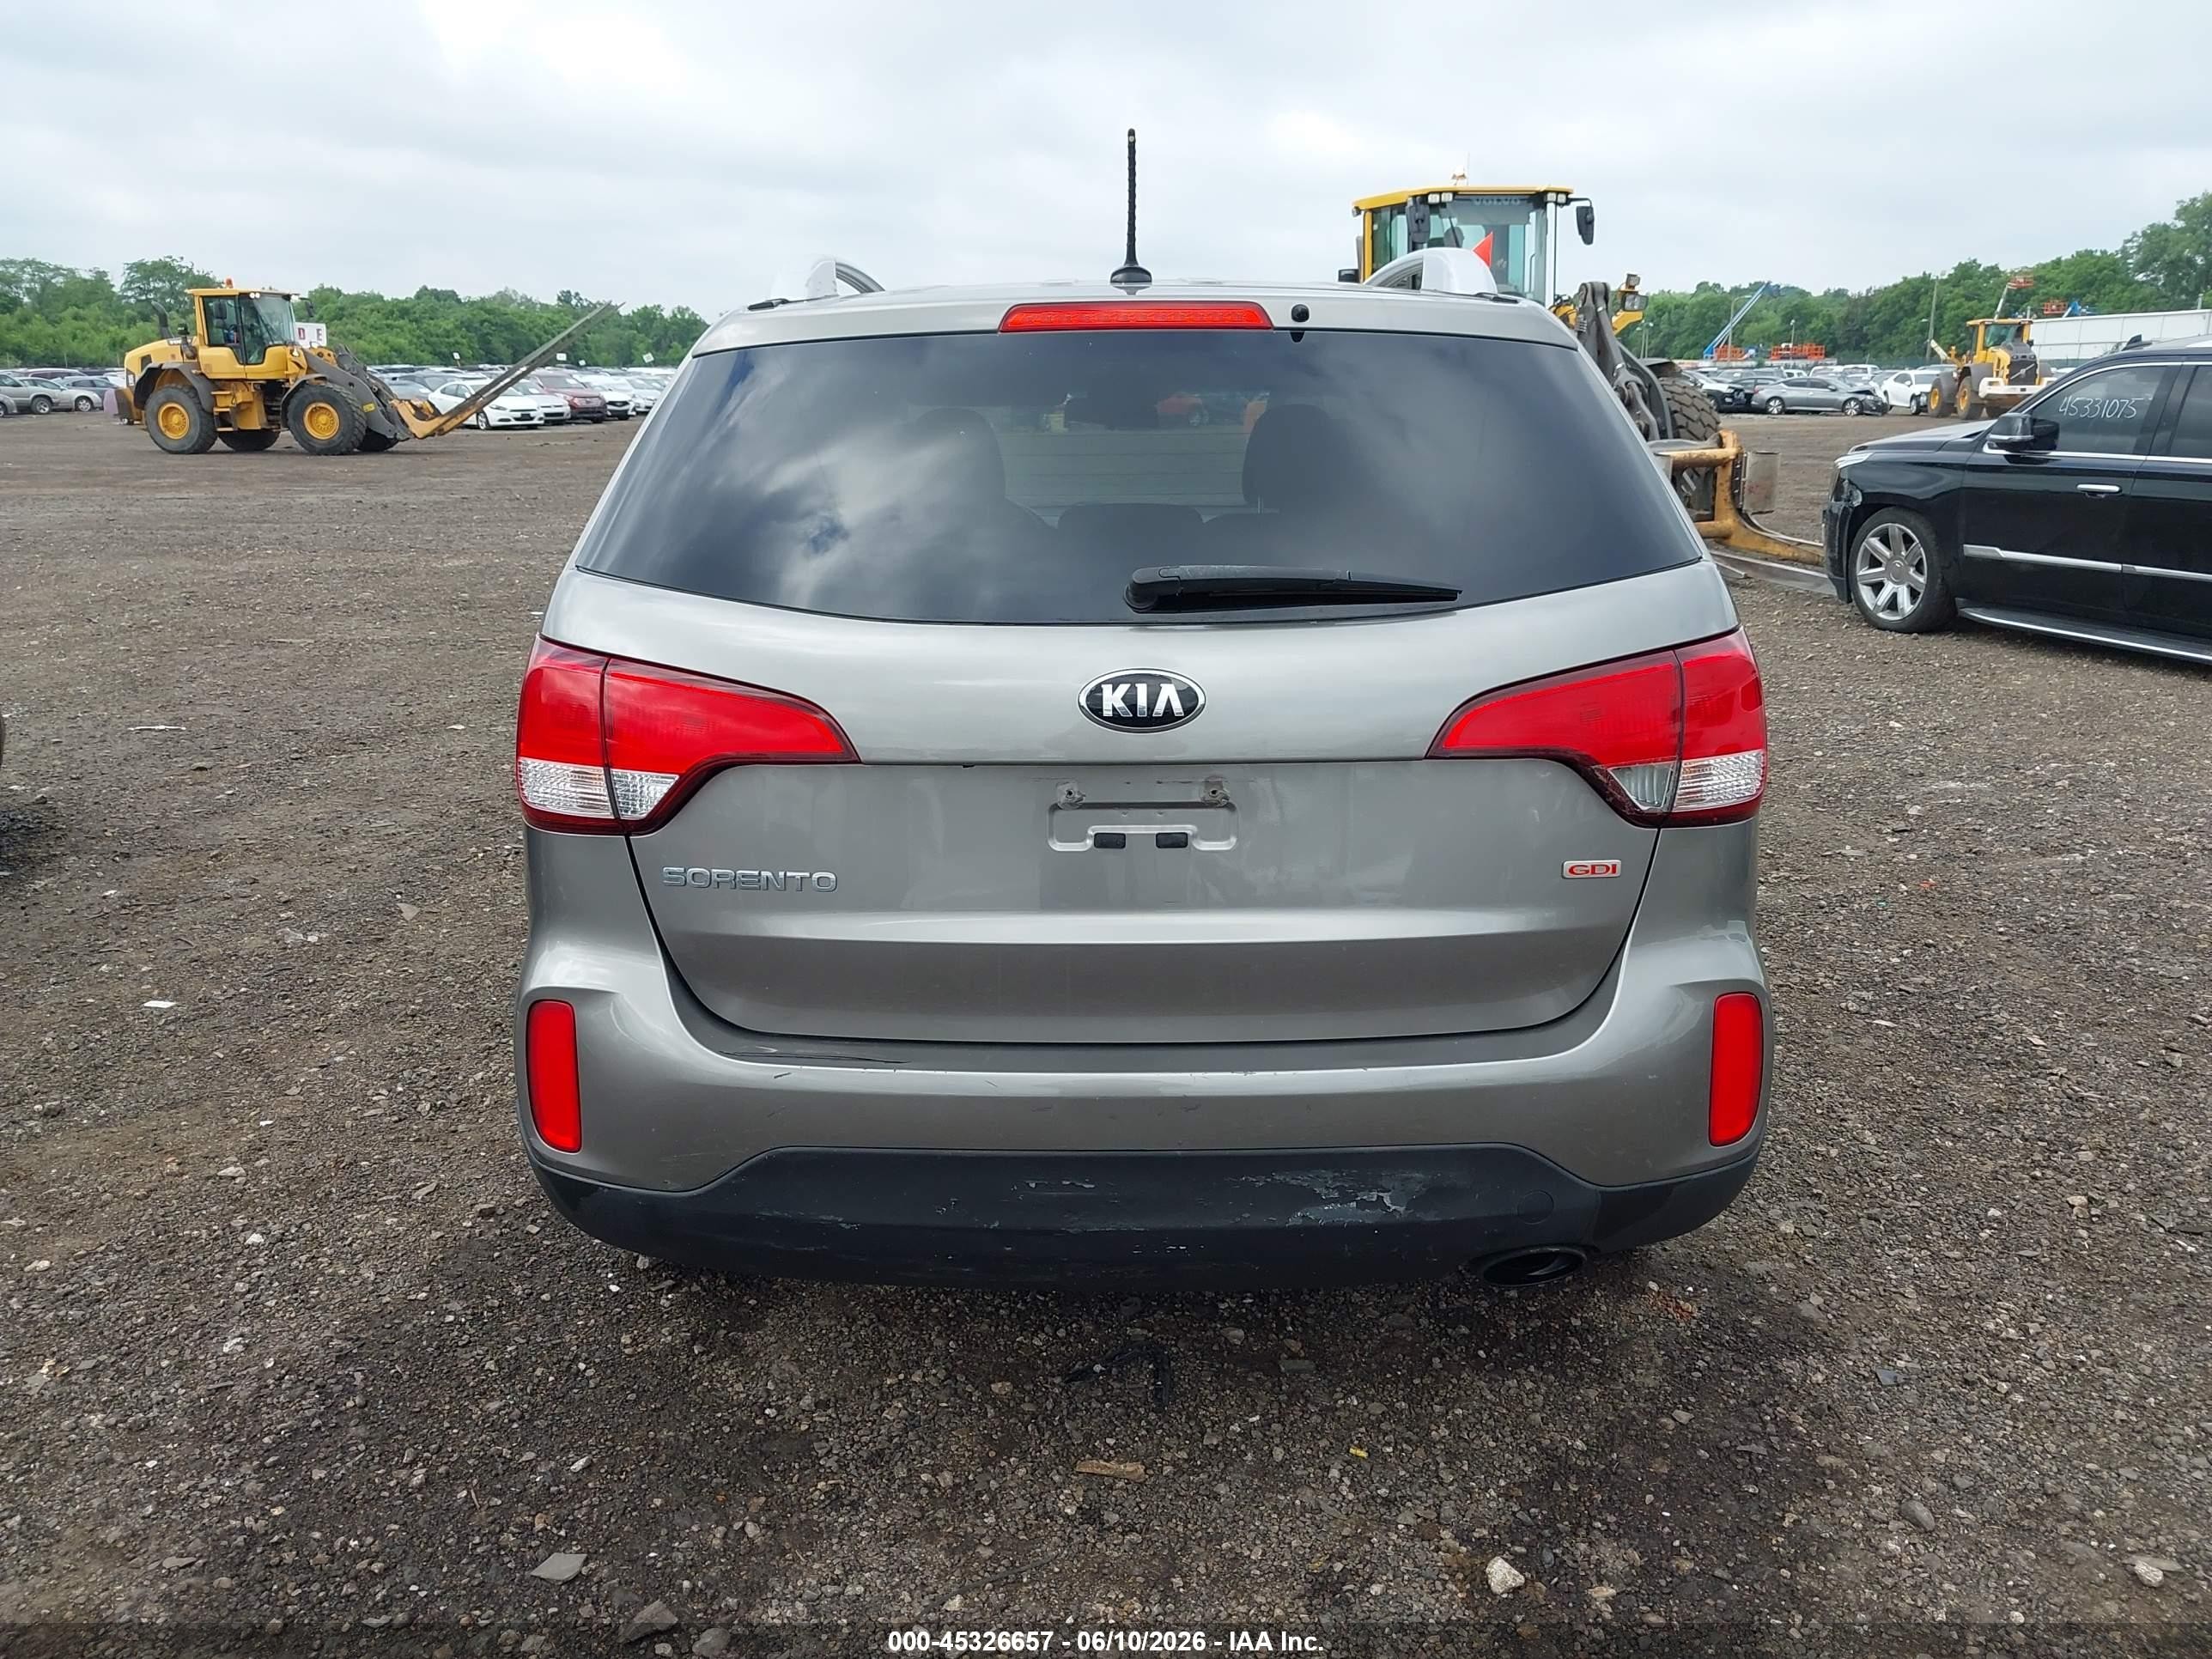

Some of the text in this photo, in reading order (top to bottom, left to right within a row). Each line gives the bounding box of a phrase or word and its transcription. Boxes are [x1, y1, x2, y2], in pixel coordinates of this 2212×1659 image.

[2058, 395, 2137, 419] 45331075
[1101, 683, 1185, 718] KIA
[662, 866, 838, 893] SORENTO
[1568, 864, 1617, 876] GDI
